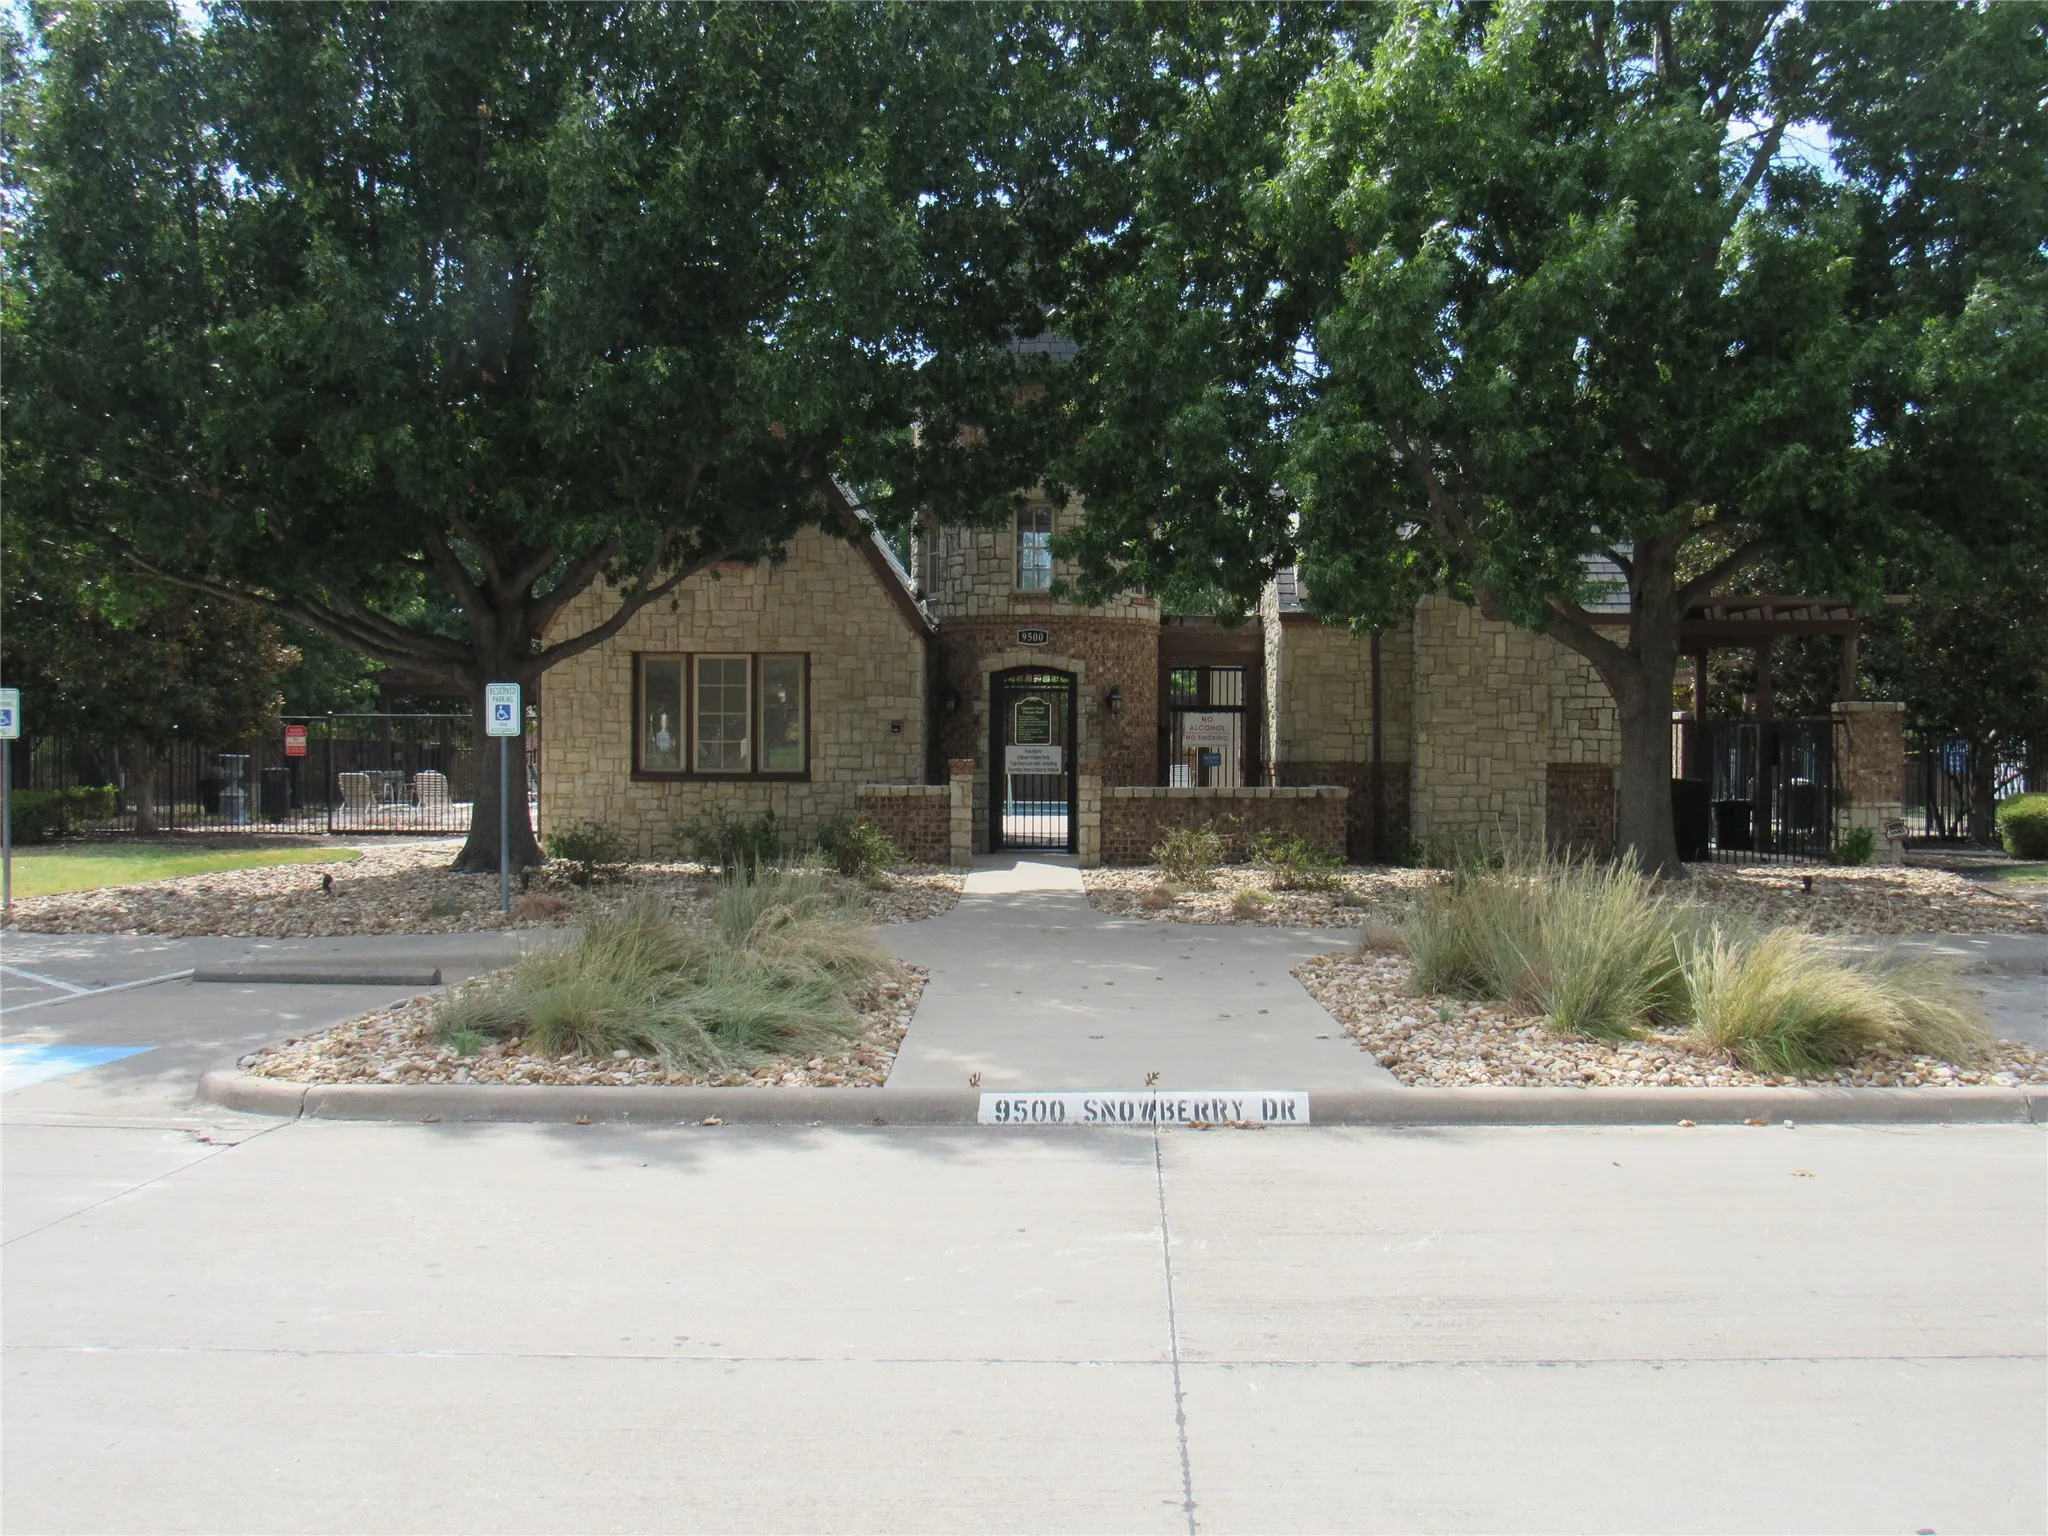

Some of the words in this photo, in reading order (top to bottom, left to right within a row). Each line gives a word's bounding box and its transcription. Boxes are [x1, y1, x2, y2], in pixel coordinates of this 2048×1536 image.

[1021, 632, 1044, 642] 9500
[490, 687, 516, 695] RESERVED
[994, 1099, 1065, 1123] 9500
[1083, 1098, 1243, 1123] SNOWBERRY
[1262, 1098, 1297, 1121] DR
